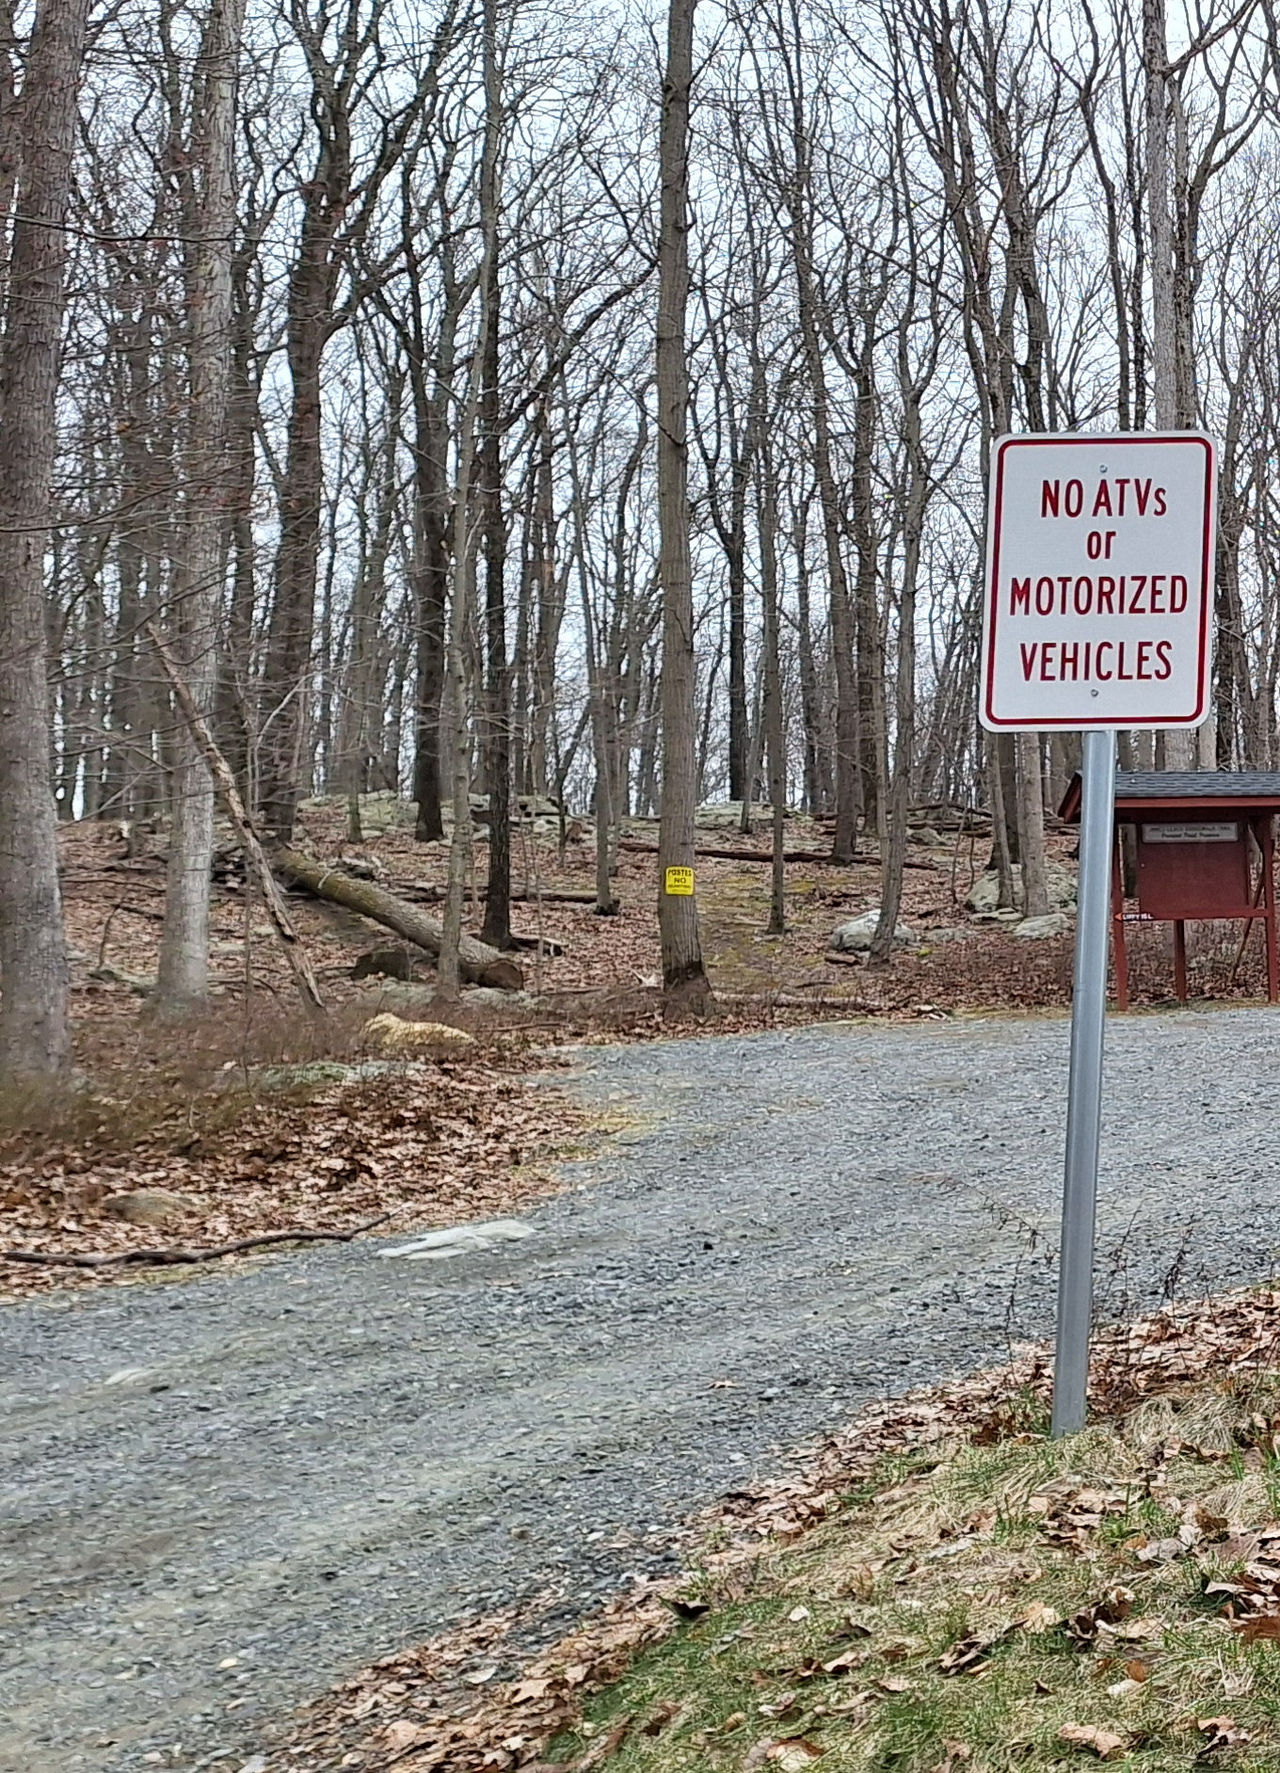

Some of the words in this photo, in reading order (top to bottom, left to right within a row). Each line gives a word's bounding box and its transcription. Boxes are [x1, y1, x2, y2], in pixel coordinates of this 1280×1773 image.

[1041, 479, 1083, 518] NO
[1091, 478, 1168, 517] ATVs
[1086, 531, 1116, 560] or
[1010, 575, 1188, 616] MOTORIZED
[1020, 641, 1173, 681] VEHICLES
